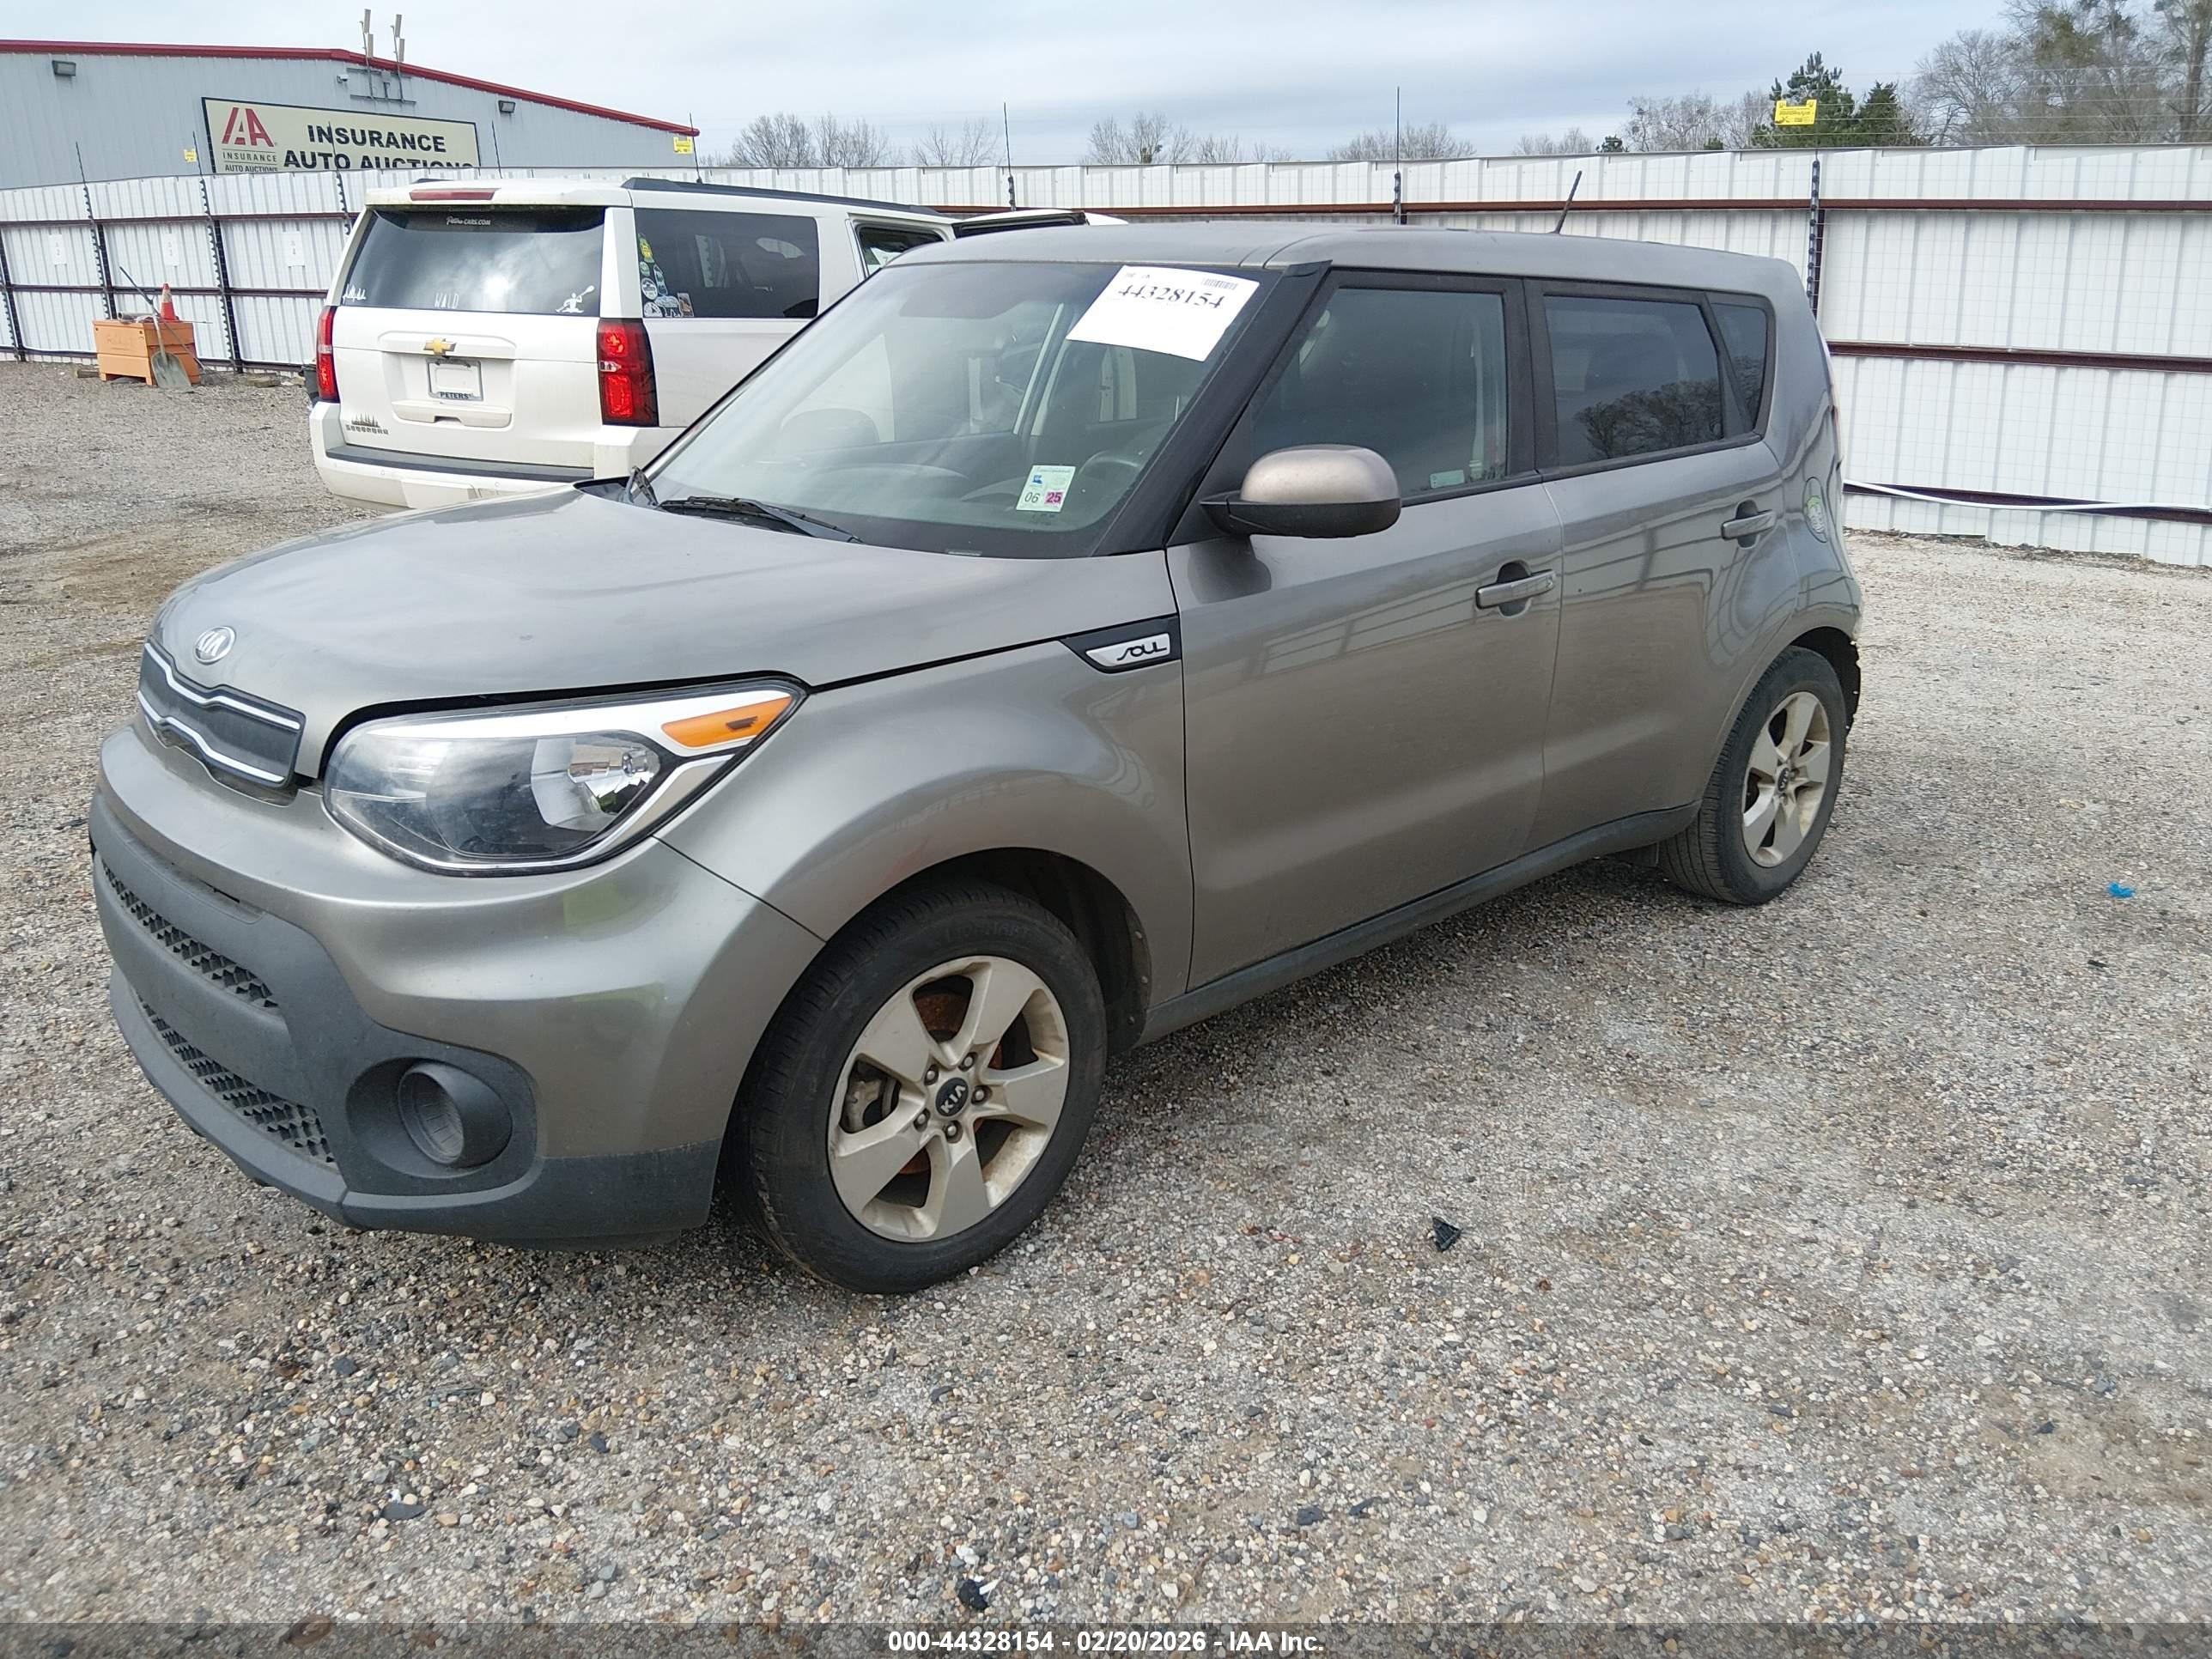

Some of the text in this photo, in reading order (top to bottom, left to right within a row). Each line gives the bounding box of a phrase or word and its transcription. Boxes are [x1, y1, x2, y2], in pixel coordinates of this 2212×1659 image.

[307, 124, 447, 153] INSURANCE
[222, 152, 277, 162] INSURANCE
[283, 149, 473, 169] AUTO AUCT
[225, 164, 243, 173] AUTO
[1118, 284, 1225, 309] 44328154
[1024, 492, 1063, 503] 06 25
[1116, 641, 1168, 661] SOUL
[940, 1085, 967, 1114] KIA
